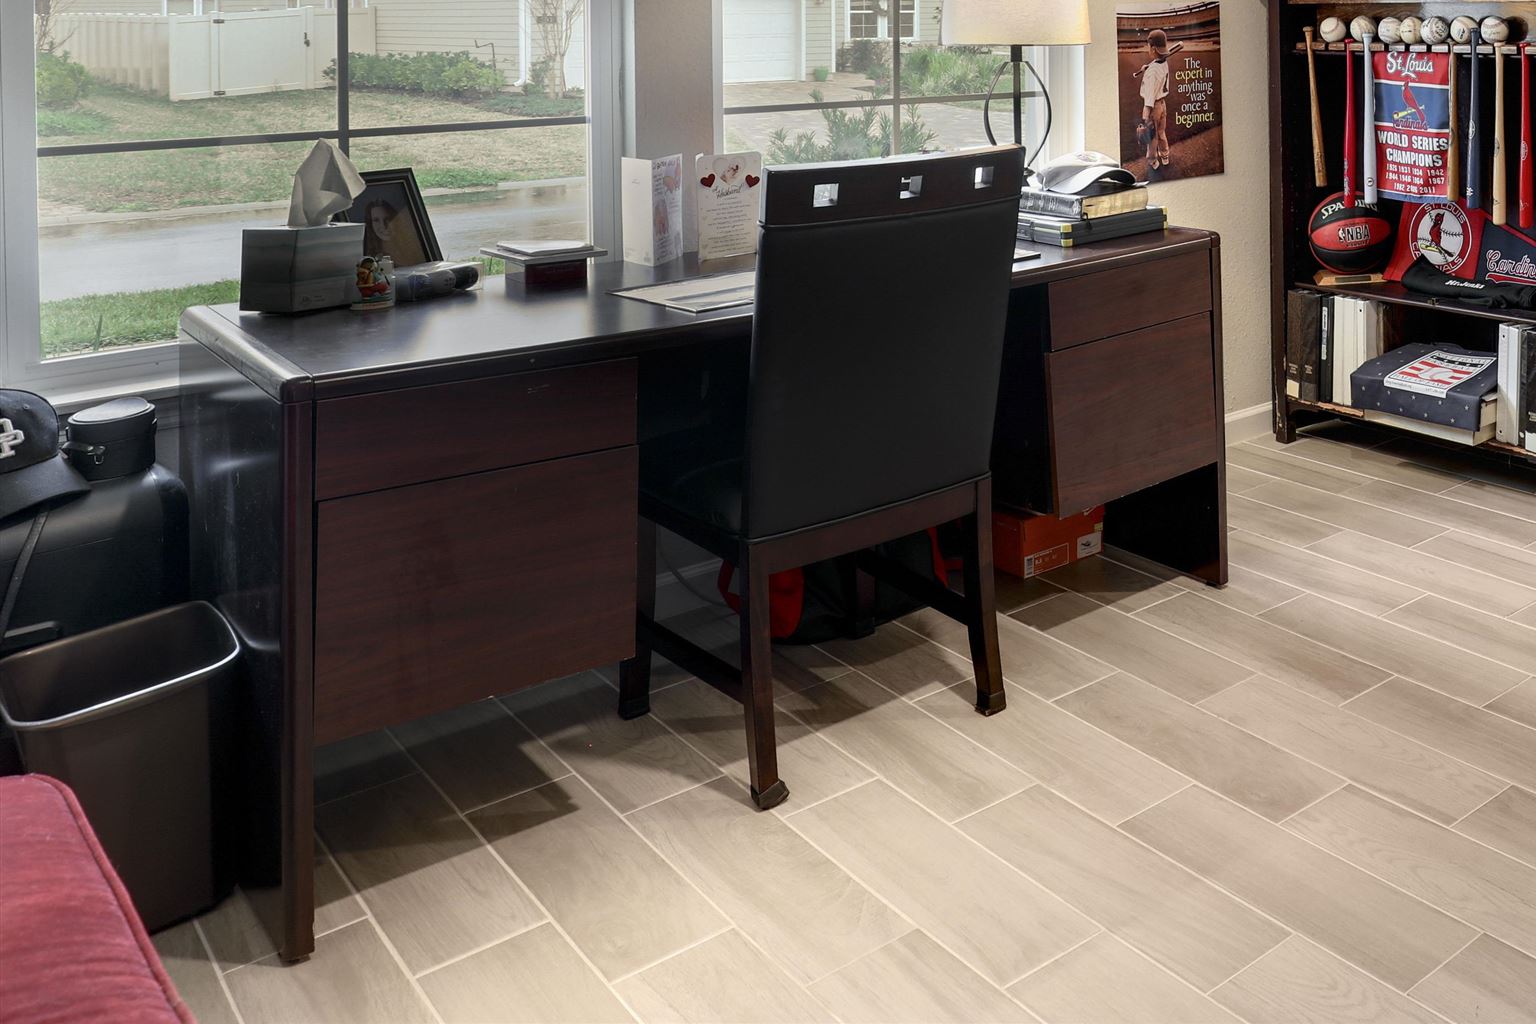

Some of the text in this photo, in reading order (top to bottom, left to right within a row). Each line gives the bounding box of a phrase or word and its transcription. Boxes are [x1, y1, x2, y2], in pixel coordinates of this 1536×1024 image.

[1184, 57, 1200, 69] The
[1401, 52, 1434, 78] Louis
[1175, 68, 1213, 83] expert in
[1177, 80, 1213, 97] anything
[1190, 92, 1206, 101] was
[1181, 102, 1208, 112] once a
[1175, 112, 1214, 128] beginner.
[1377, 130, 1449, 151] WORLD SERIES
[1385, 147, 1443, 168] CHAMPIONS
[1428, 177, 1445, 185] 1967
[1420, 185, 1436, 194] 2011
[1440, 201, 1466, 224] LOUIS
[1345, 223, 1371, 243] NBA
[1412, 241, 1463, 273] CAALS
